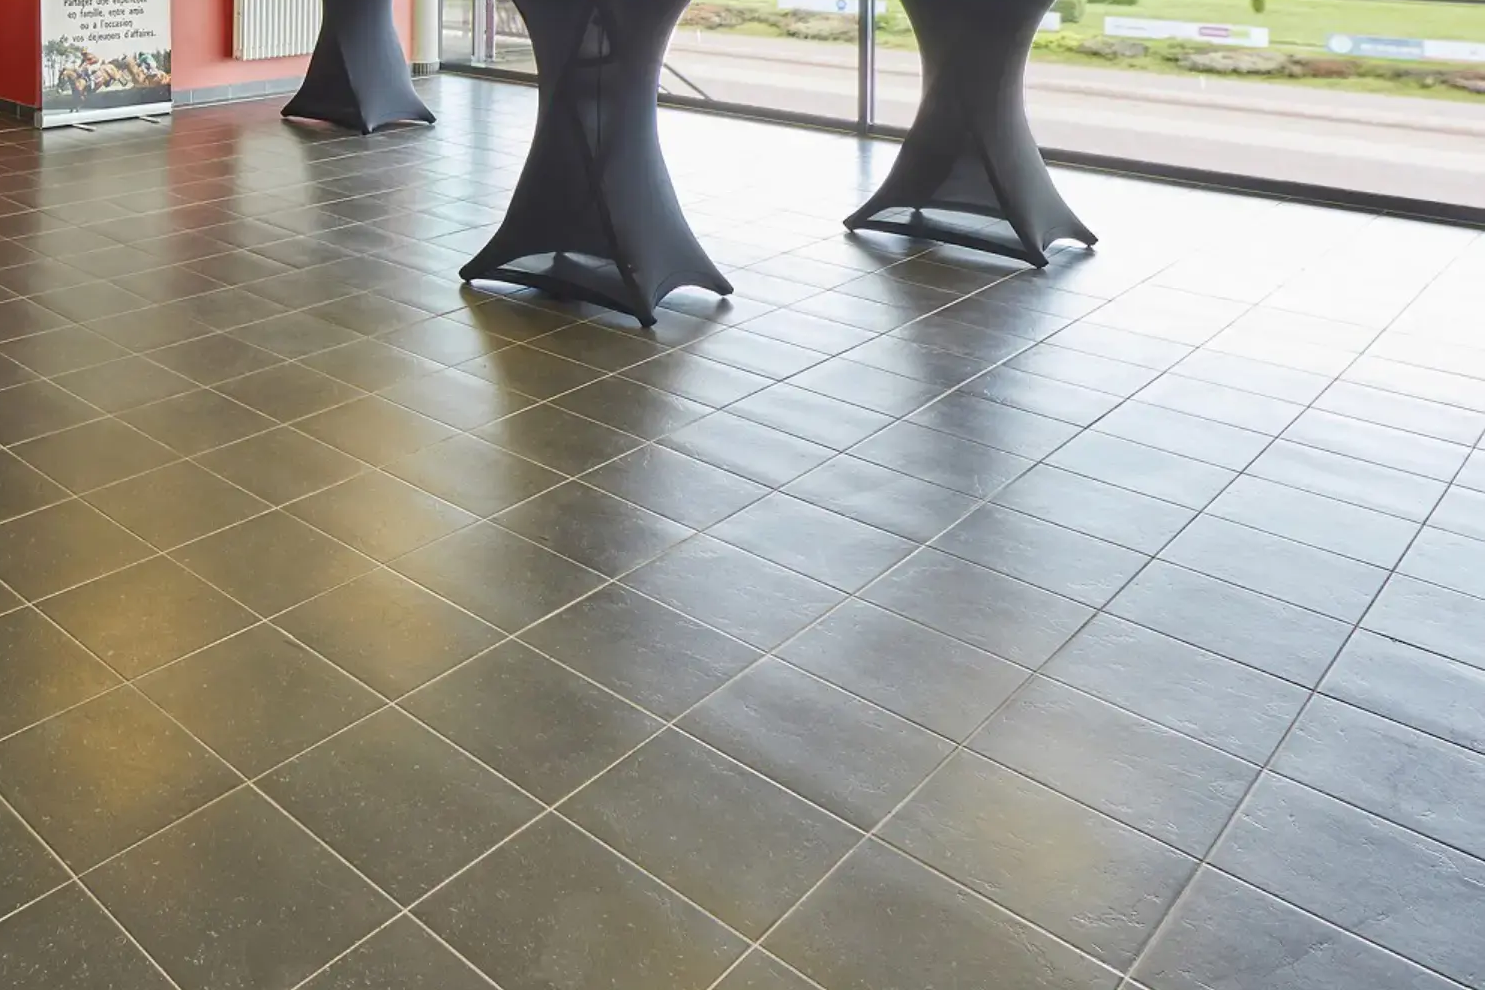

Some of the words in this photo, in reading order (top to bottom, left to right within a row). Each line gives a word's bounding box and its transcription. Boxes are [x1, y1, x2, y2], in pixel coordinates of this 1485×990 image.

[67, 11, 77, 20] en
[80, 8, 106, 18] famille,
[108, 8, 126, 18] entre
[128, 6, 145, 16] amis
[79, 22, 89, 30] ou
[100, 18, 134, 29] l'occasion
[59, 34, 69, 43] de
[72, 35, 85, 43] vos
